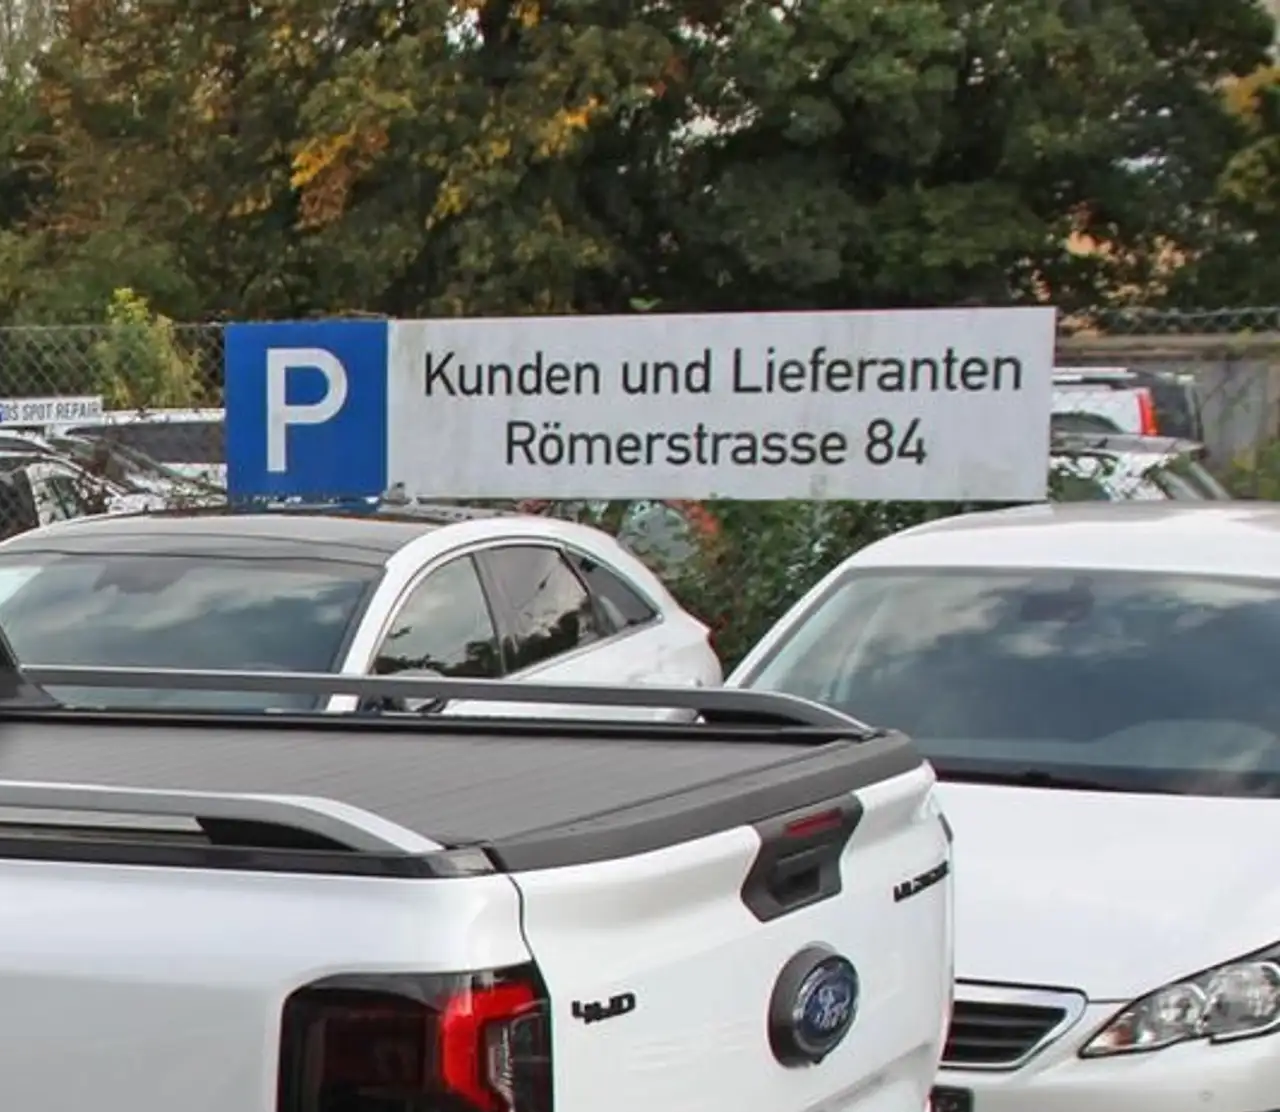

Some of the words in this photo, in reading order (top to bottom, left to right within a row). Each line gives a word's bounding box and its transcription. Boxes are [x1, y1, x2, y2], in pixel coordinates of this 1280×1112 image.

[424, 350, 601, 397] Kunden
[622, 347, 712, 395] und
[733, 345, 1022, 394] Lieferanten
[267, 347, 348, 472] P
[505, 420, 848, 466] Römerstrasse
[865, 417, 927, 465] 84
